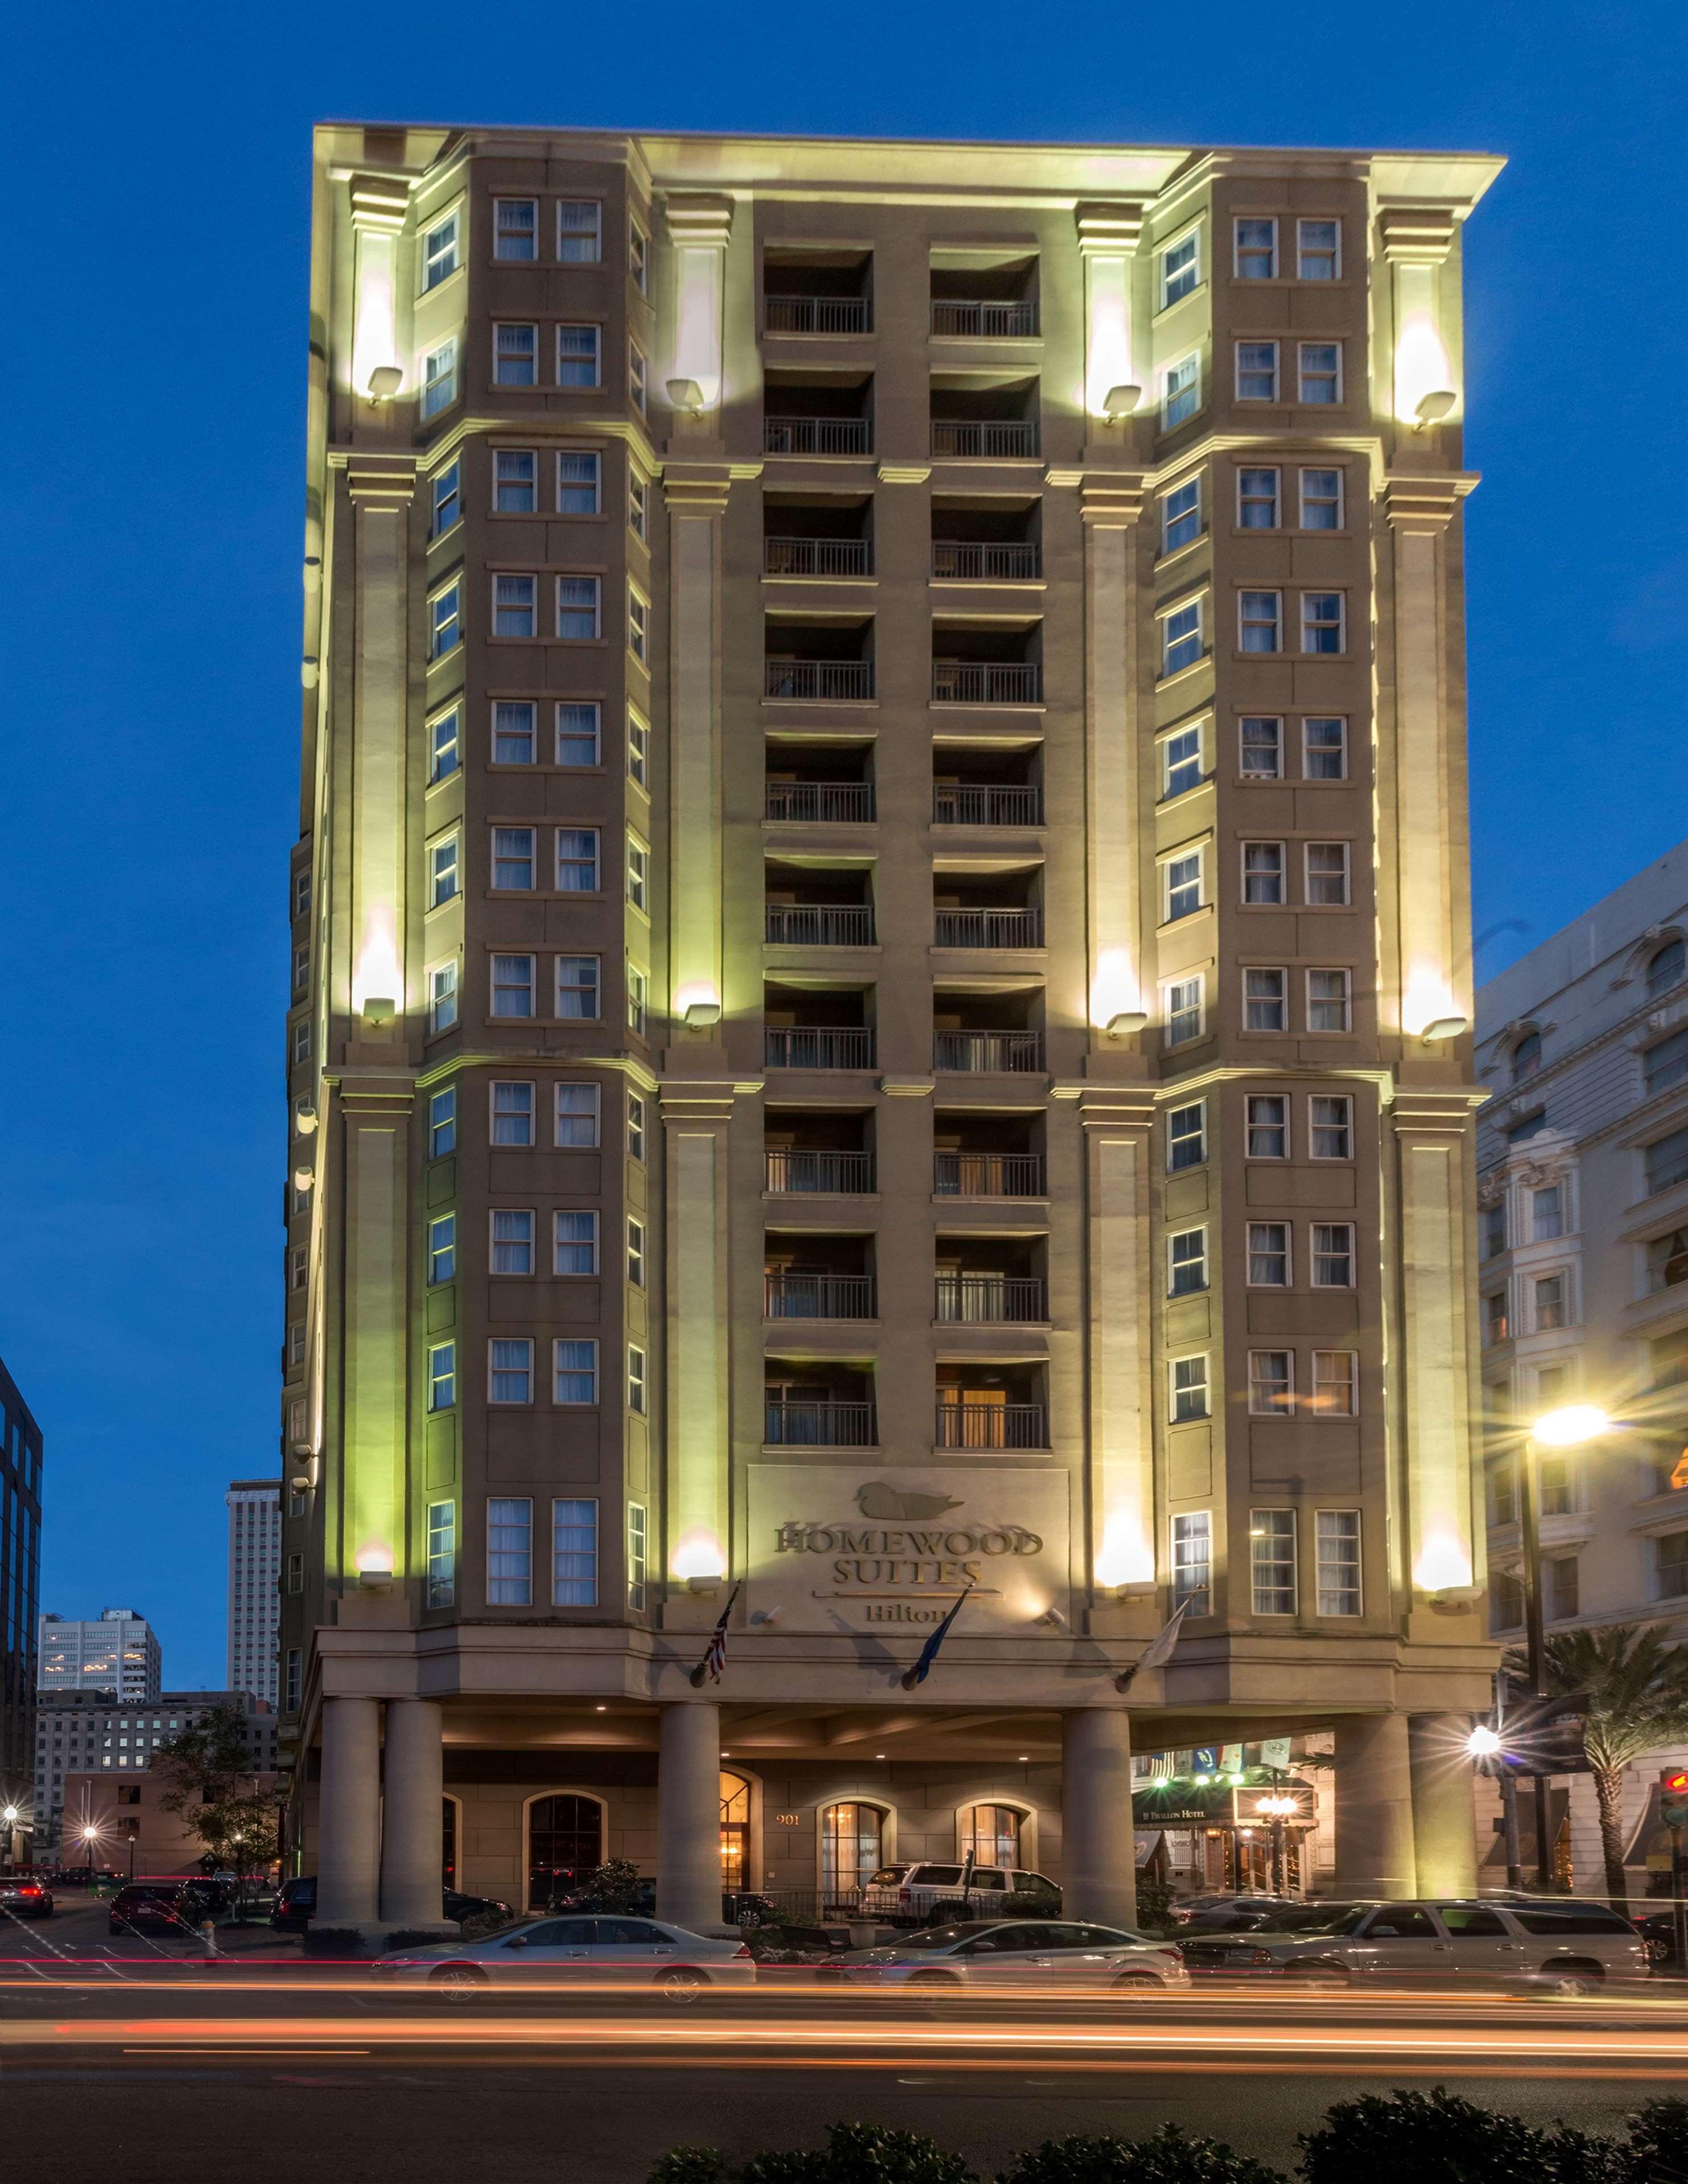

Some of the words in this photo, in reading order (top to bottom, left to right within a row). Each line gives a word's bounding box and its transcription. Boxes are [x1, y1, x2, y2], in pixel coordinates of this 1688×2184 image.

[774, 1528, 1043, 1557] HOMEWOOD
[832, 1559, 982, 1584] SUITES
[865, 1603, 949, 1622] Hilton
[776, 1814, 799, 1826] 901
[1182, 1810, 1206, 1818] HOTEL
